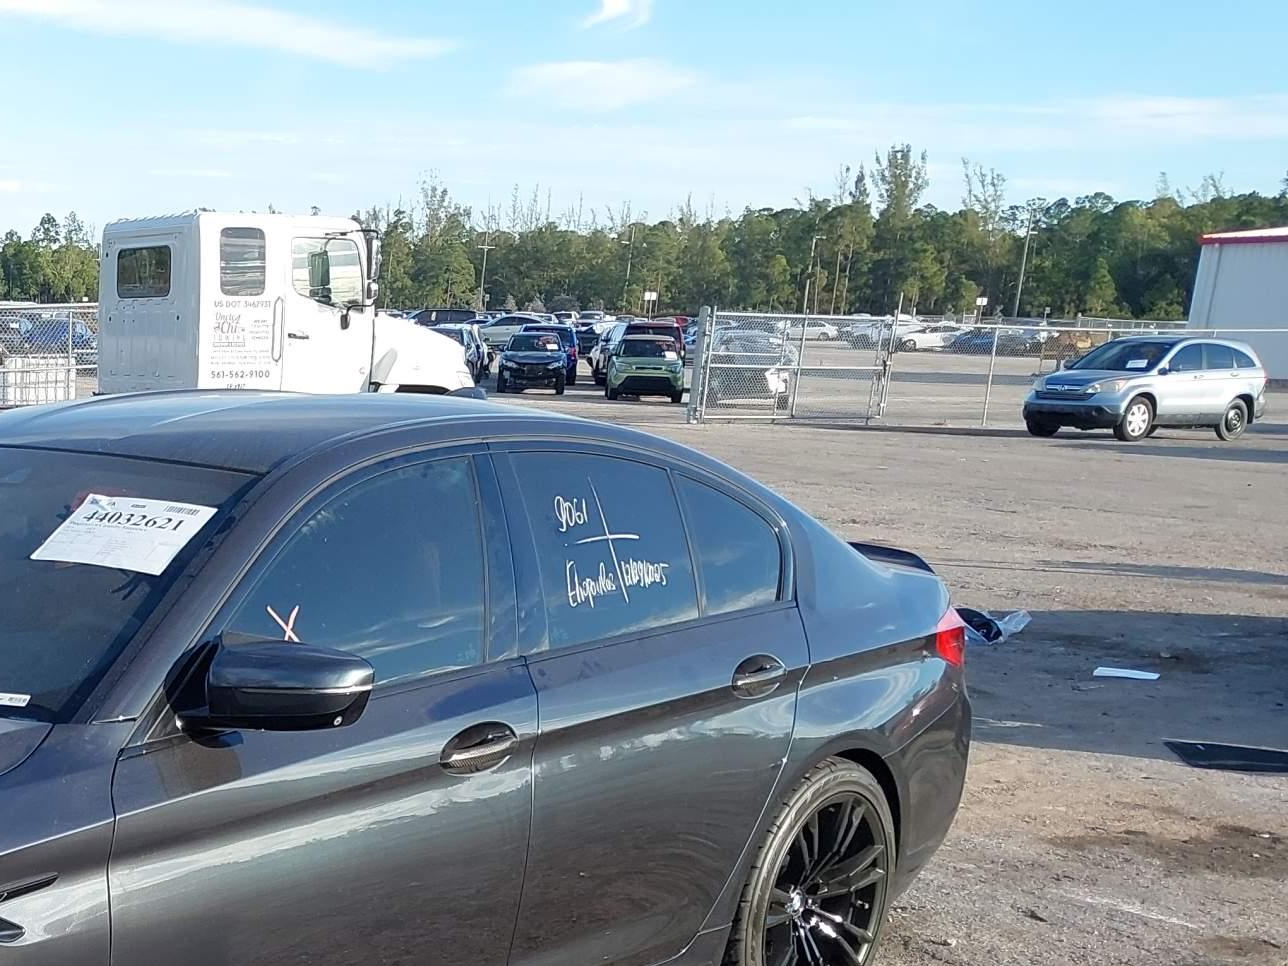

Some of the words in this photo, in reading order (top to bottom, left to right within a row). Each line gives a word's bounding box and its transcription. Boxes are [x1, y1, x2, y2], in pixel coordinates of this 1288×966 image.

[211, 370, 270, 379] 561-562-9100
[83, 510, 185, 531] 44032621
[554, 495, 588, 532] 9061
